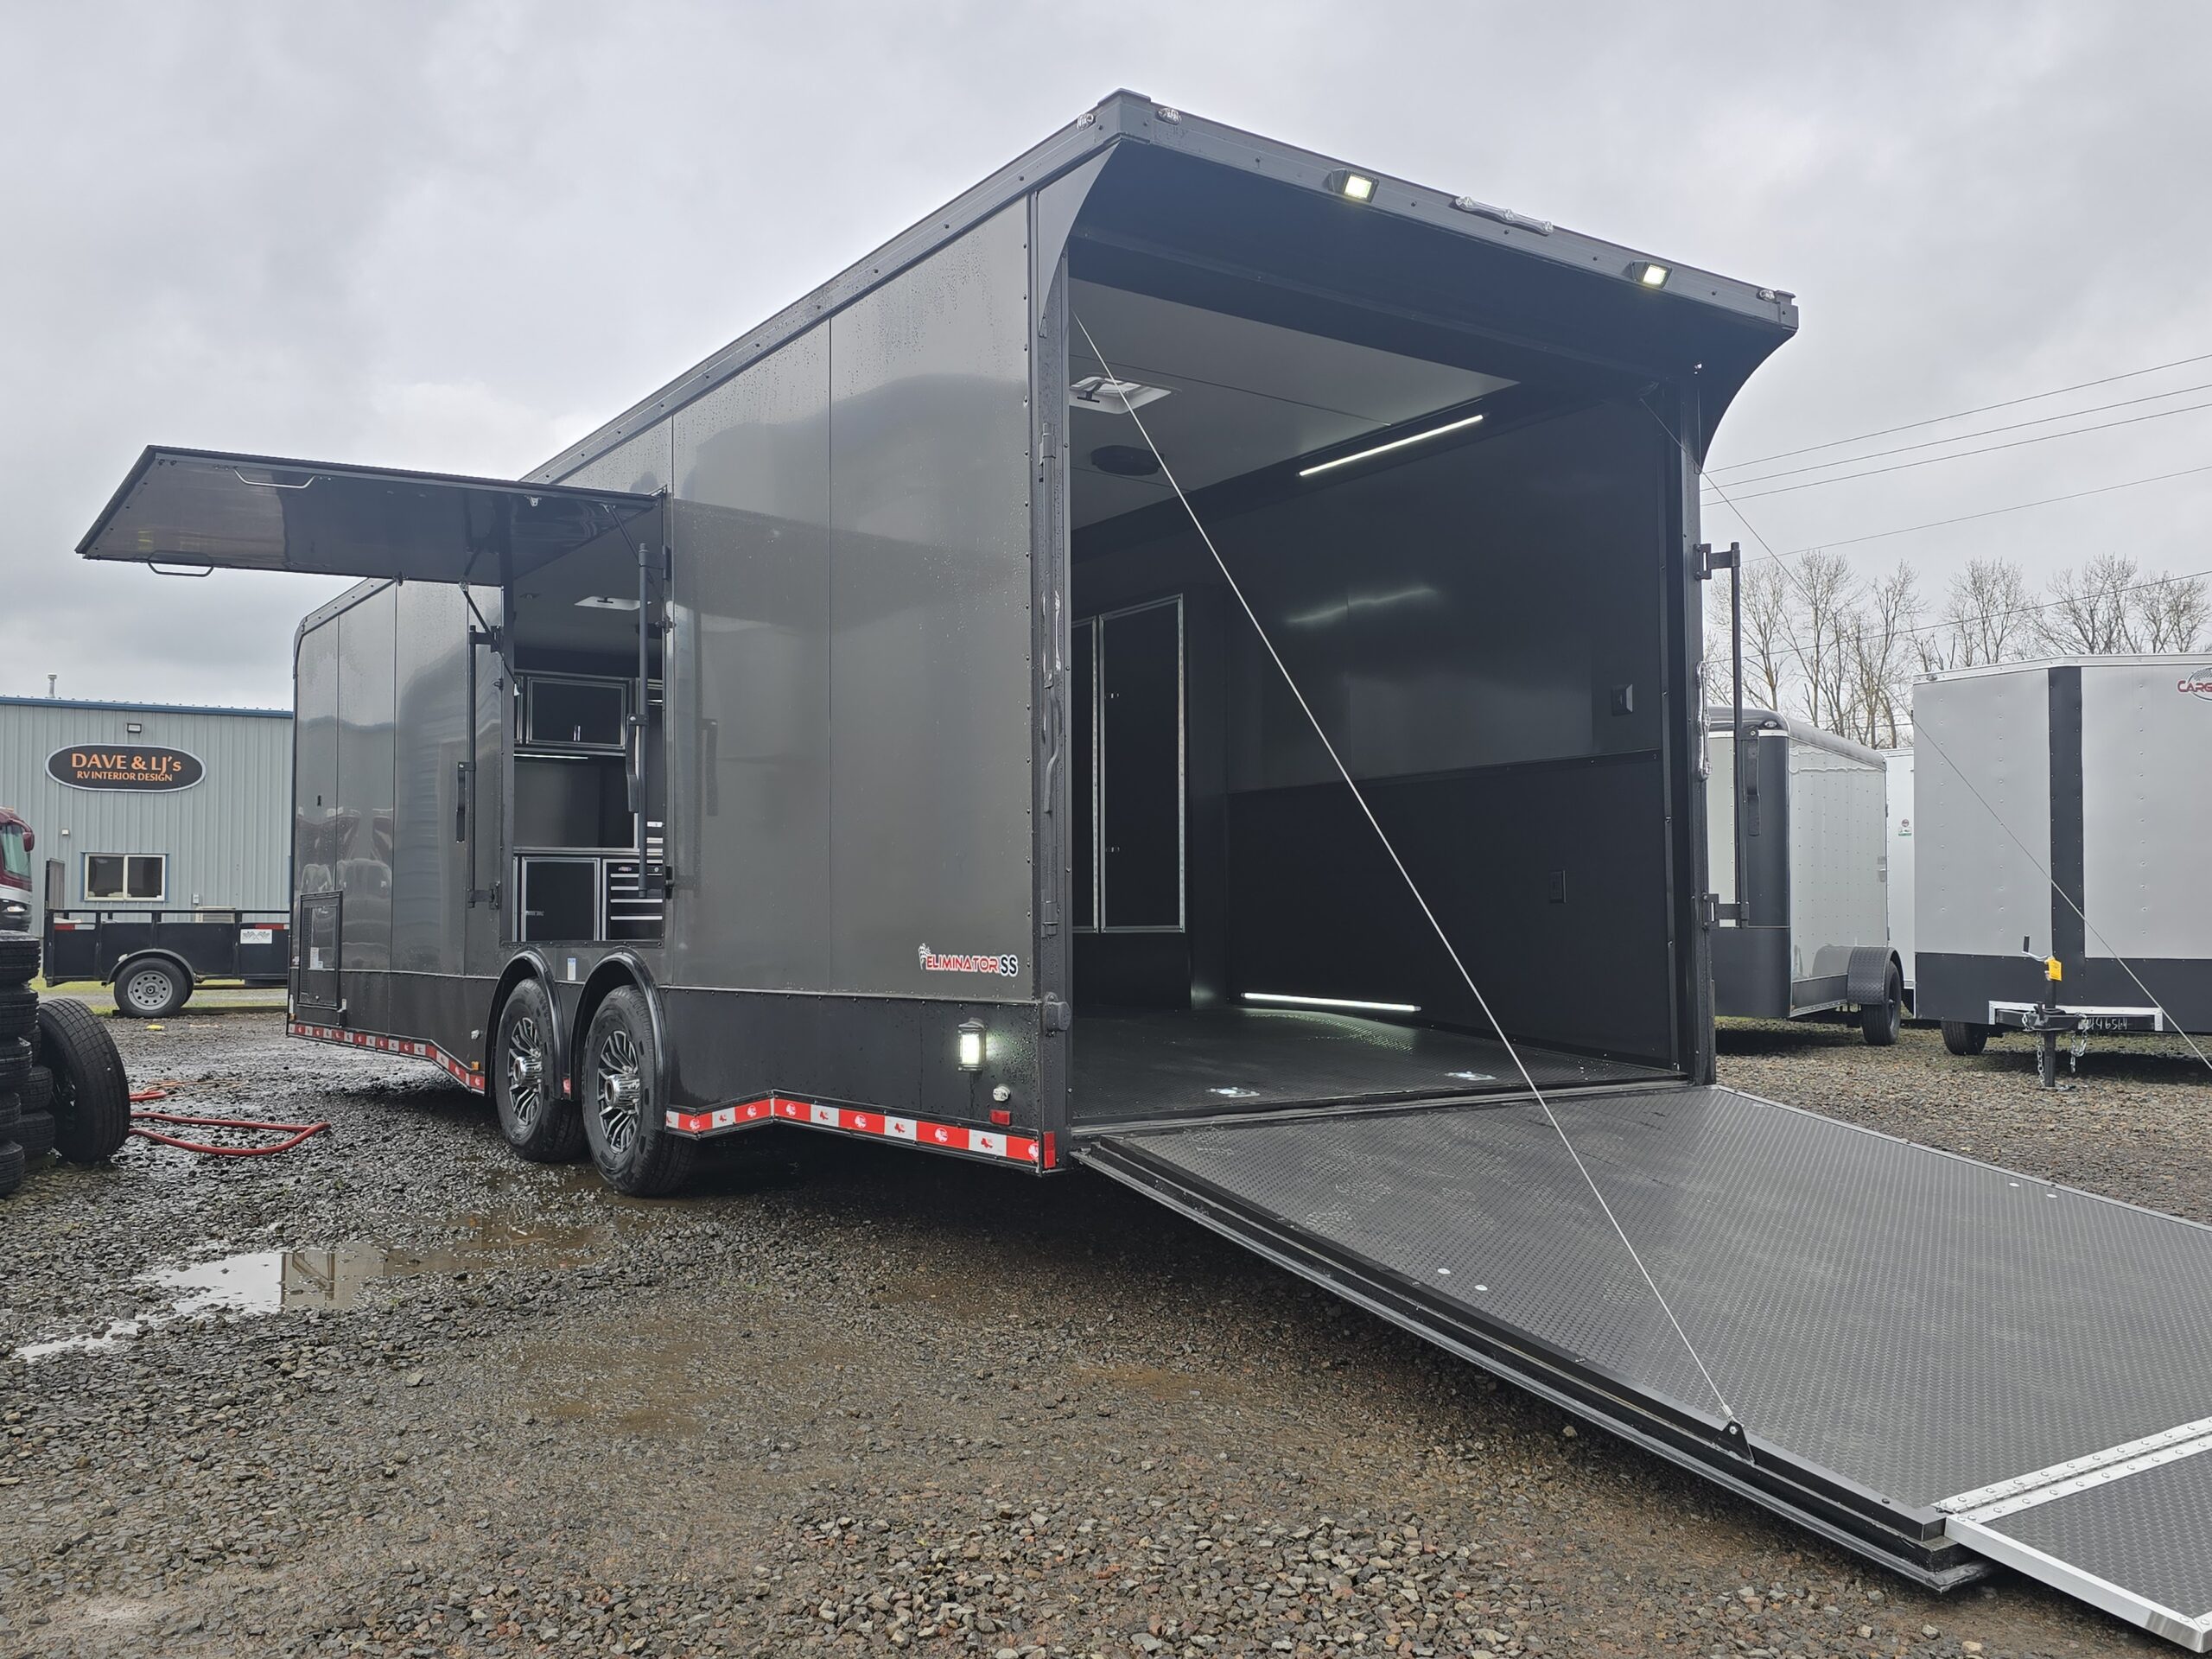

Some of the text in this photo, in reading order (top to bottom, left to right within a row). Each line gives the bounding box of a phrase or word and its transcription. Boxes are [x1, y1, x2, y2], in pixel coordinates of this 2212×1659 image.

[72, 753, 182, 774] DAVE & LJ's
[77, 771, 173, 782] RV INTERIOR DESIGN
